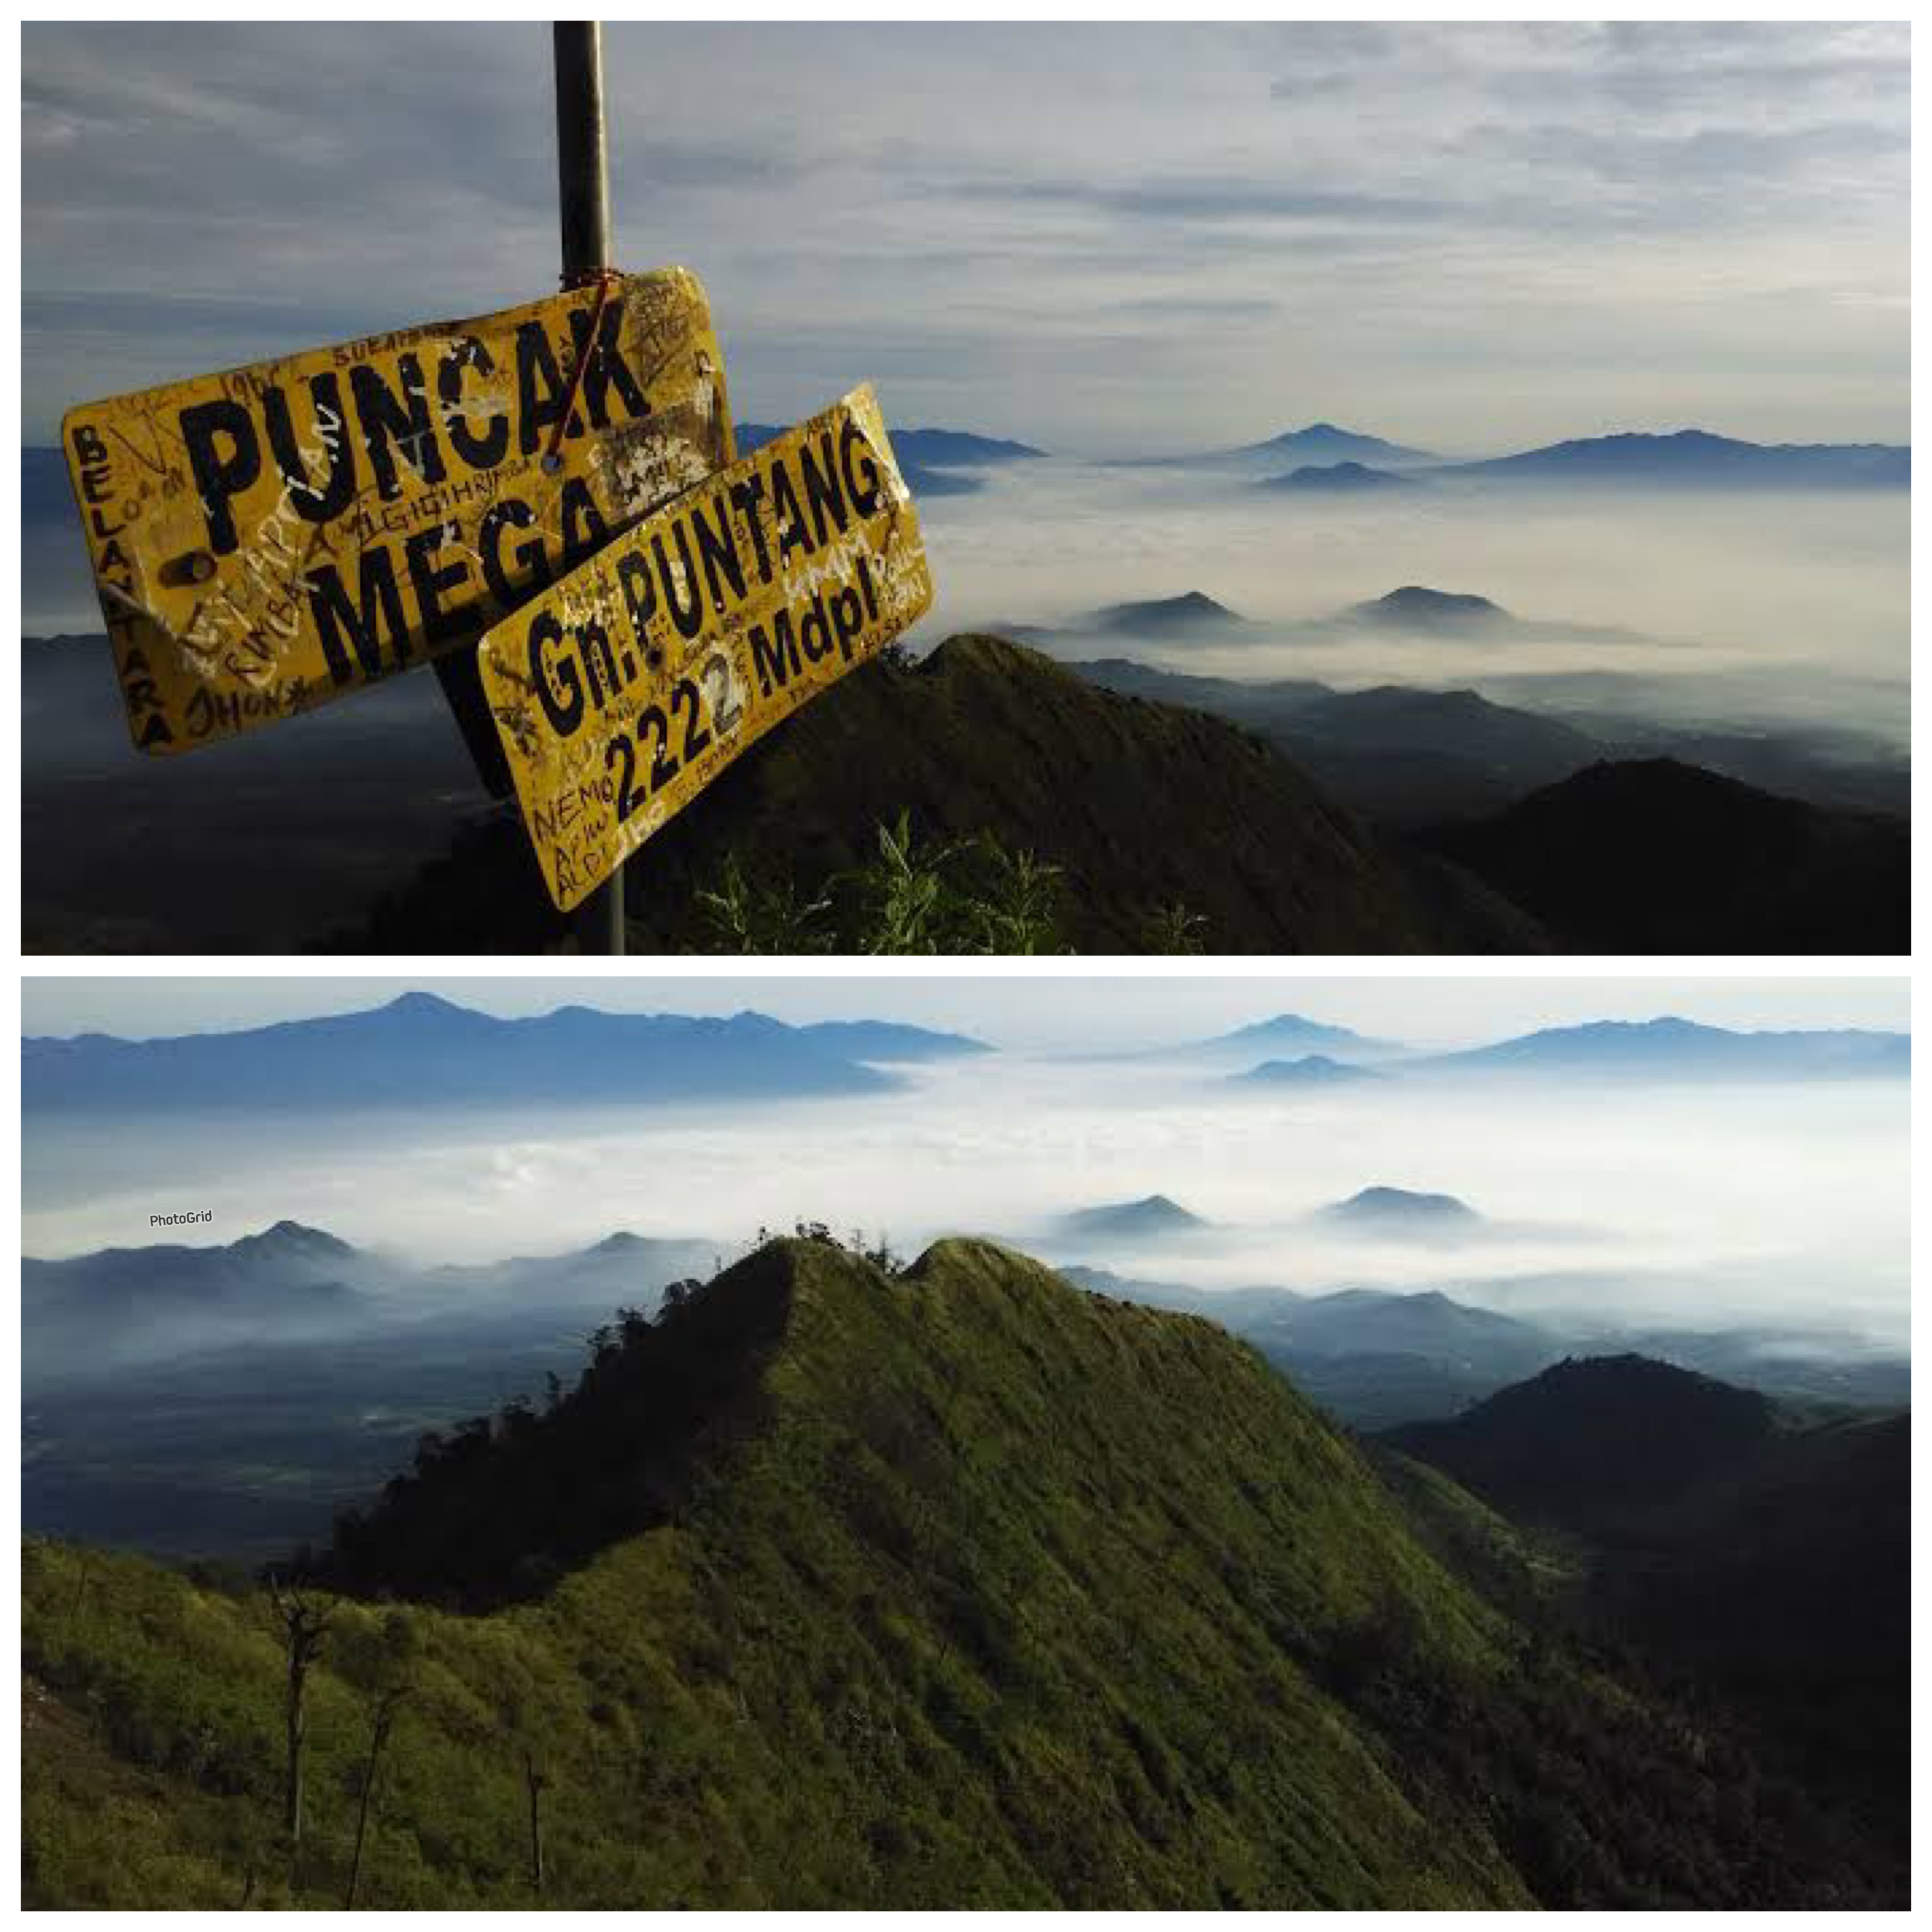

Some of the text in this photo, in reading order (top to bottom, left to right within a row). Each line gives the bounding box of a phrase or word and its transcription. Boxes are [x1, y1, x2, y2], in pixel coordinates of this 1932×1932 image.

[179, 303, 652, 555] PUNCAK
[306, 475, 609, 687] MEGA
[748, 556, 879, 697] Mdpl
[604, 652, 743, 823] 2222
